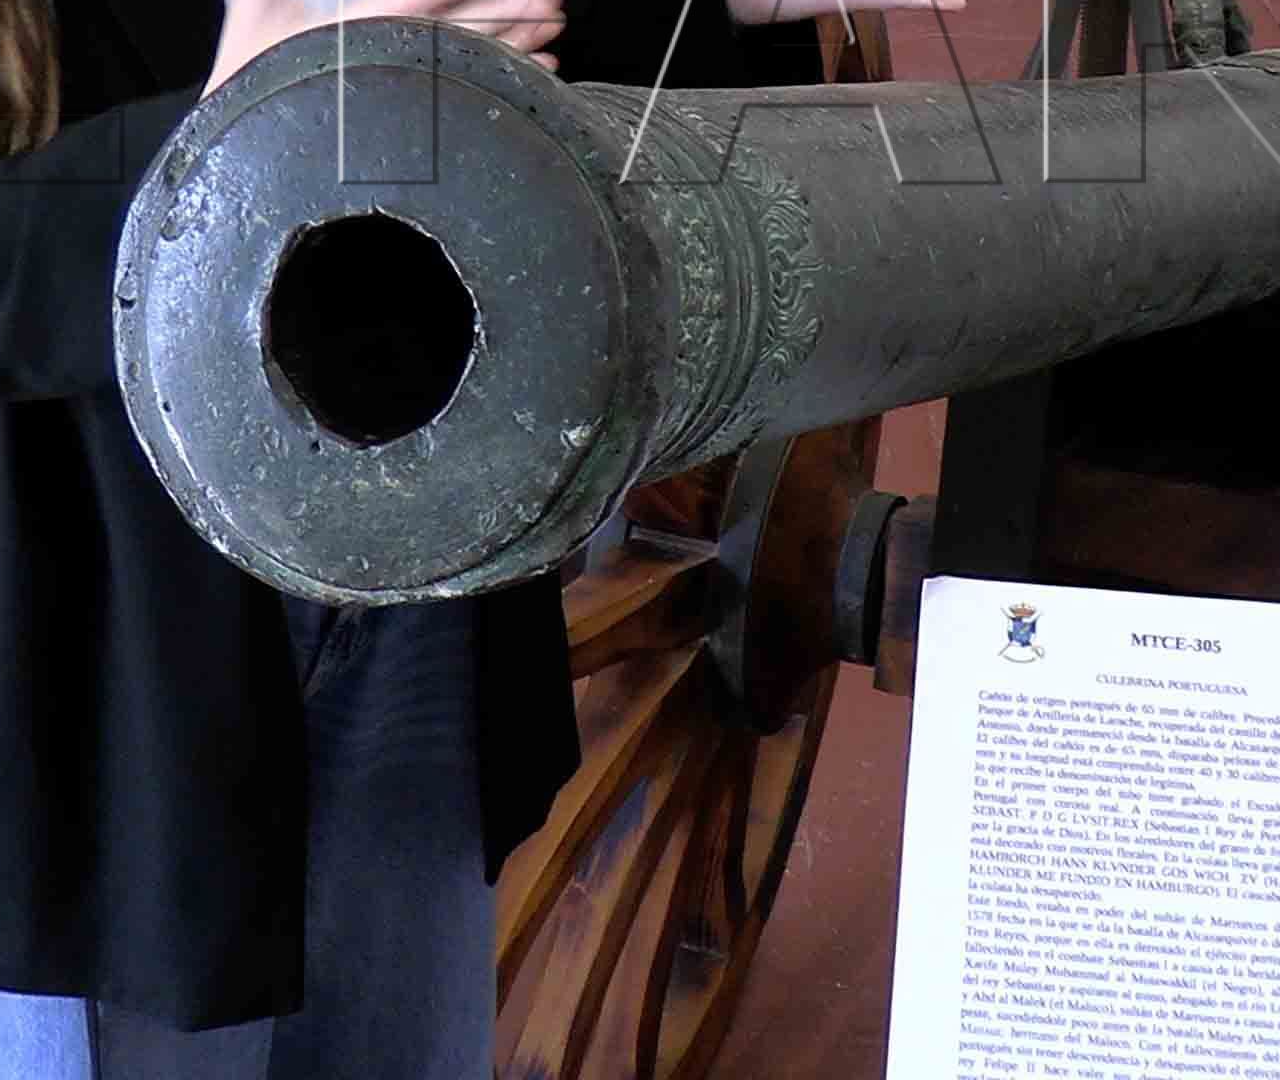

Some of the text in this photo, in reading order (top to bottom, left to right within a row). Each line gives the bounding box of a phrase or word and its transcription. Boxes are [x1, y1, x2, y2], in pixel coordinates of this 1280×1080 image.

[1130, 632, 1222, 654] MTCE-305
[1095, 673, 1249, 696] CULEBRINA PORTUGUESA
